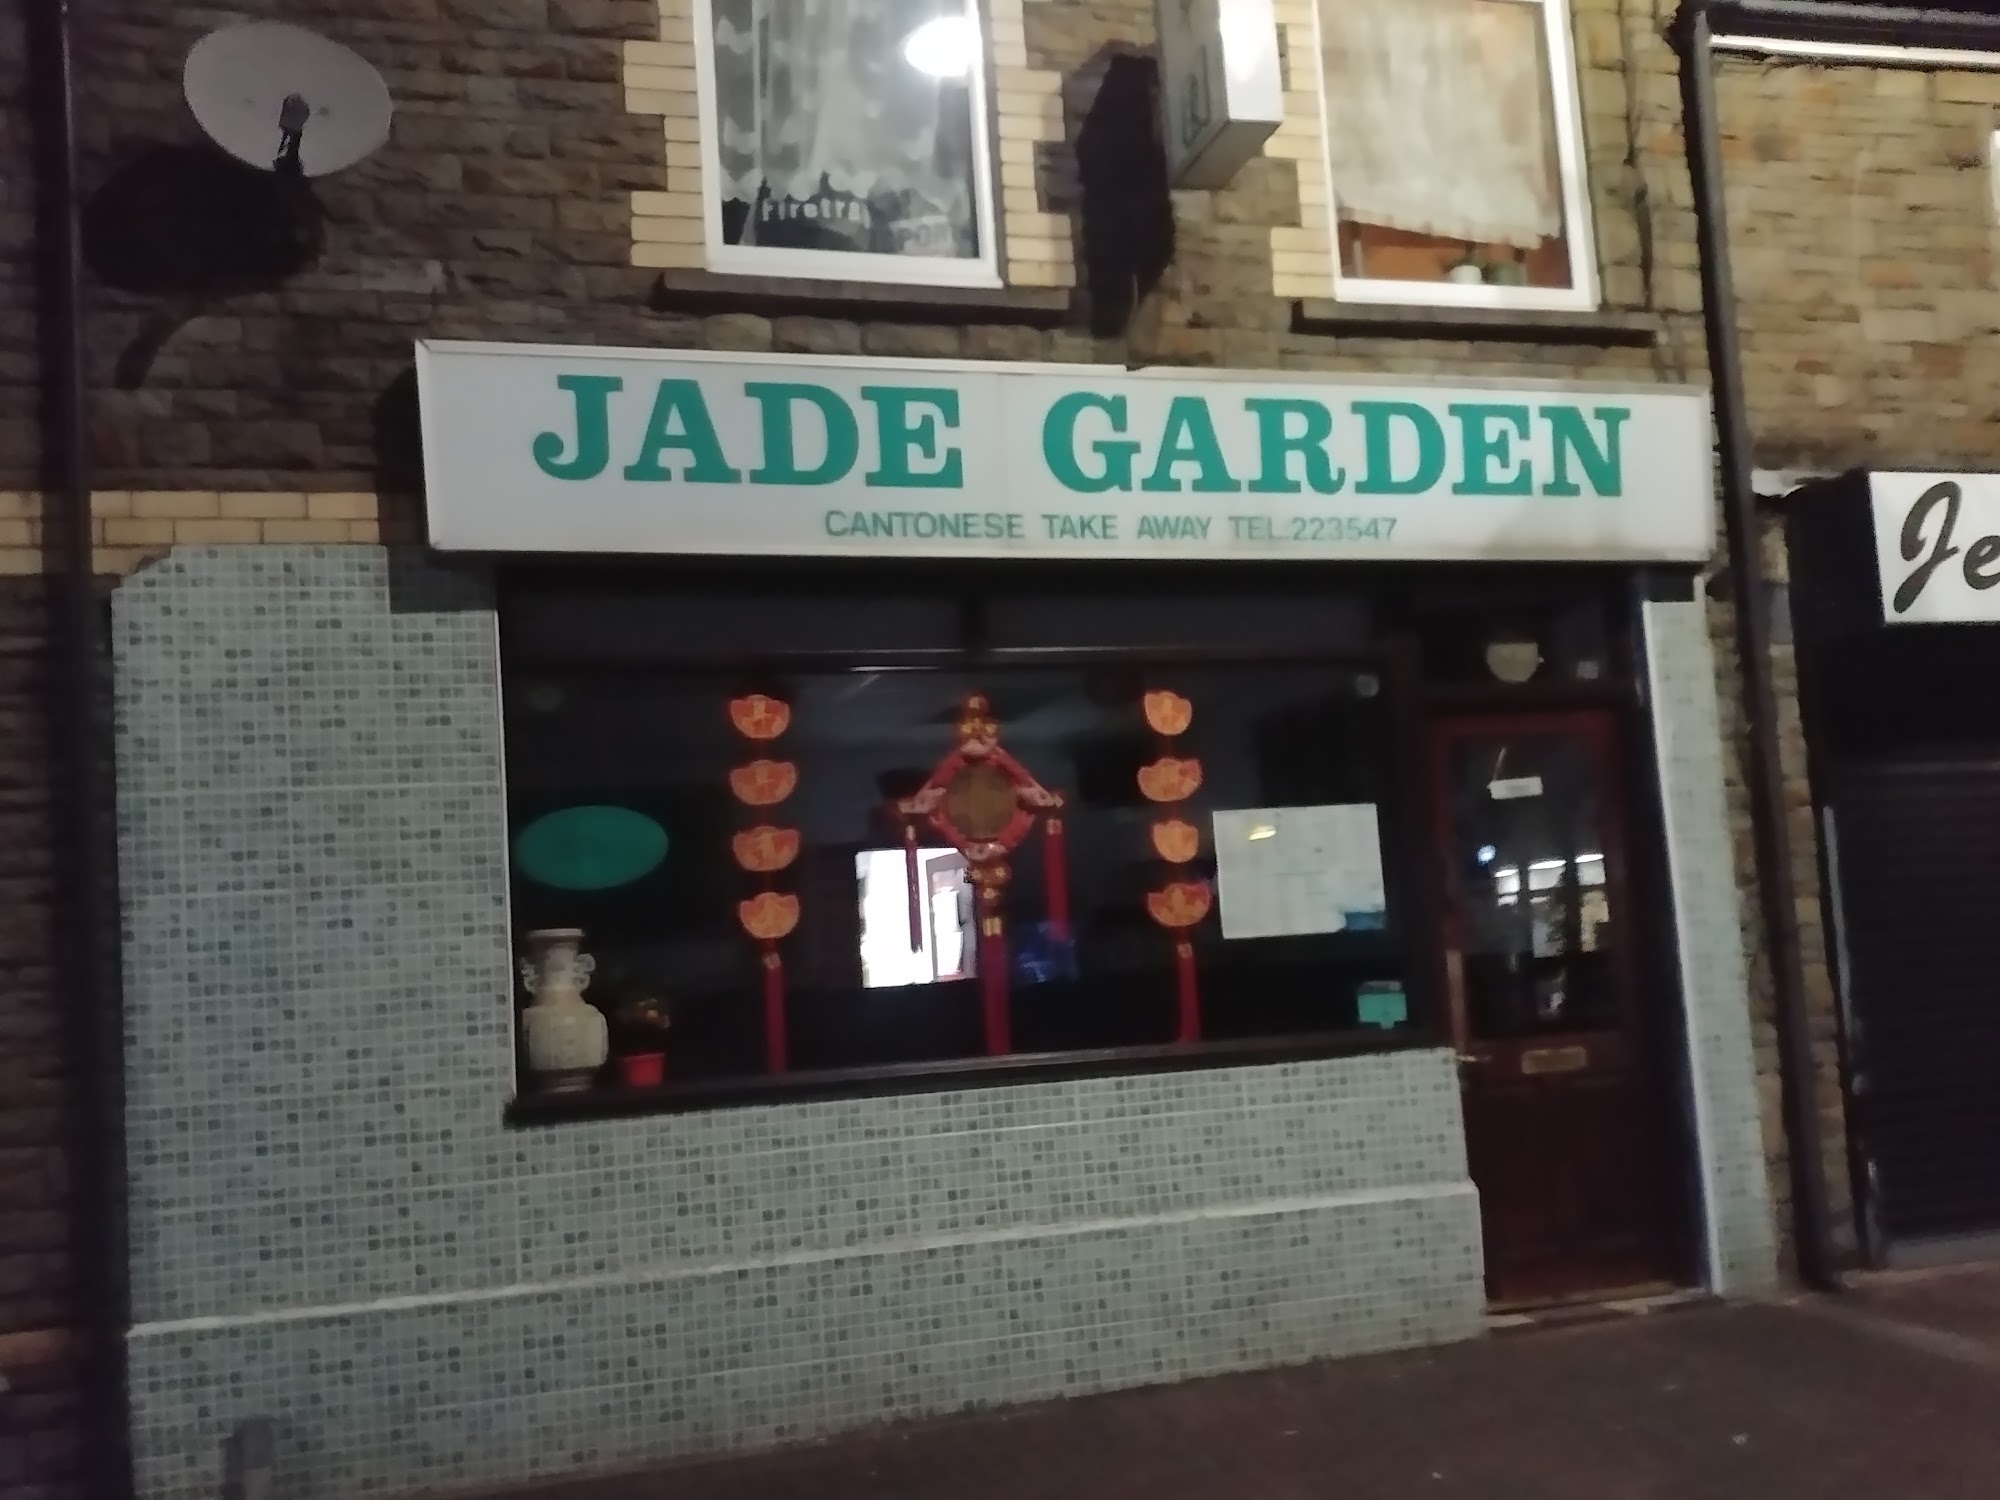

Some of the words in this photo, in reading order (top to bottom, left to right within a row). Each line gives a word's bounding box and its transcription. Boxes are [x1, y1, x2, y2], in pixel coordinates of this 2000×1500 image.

[532, 374, 964, 489] JADE
[1041, 391, 1631, 498] GARDEN
[825, 510, 1025, 539] CANTONESE
[1041, 513, 1119, 540] TAKE
[1136, 514, 1212, 540] AWAY
